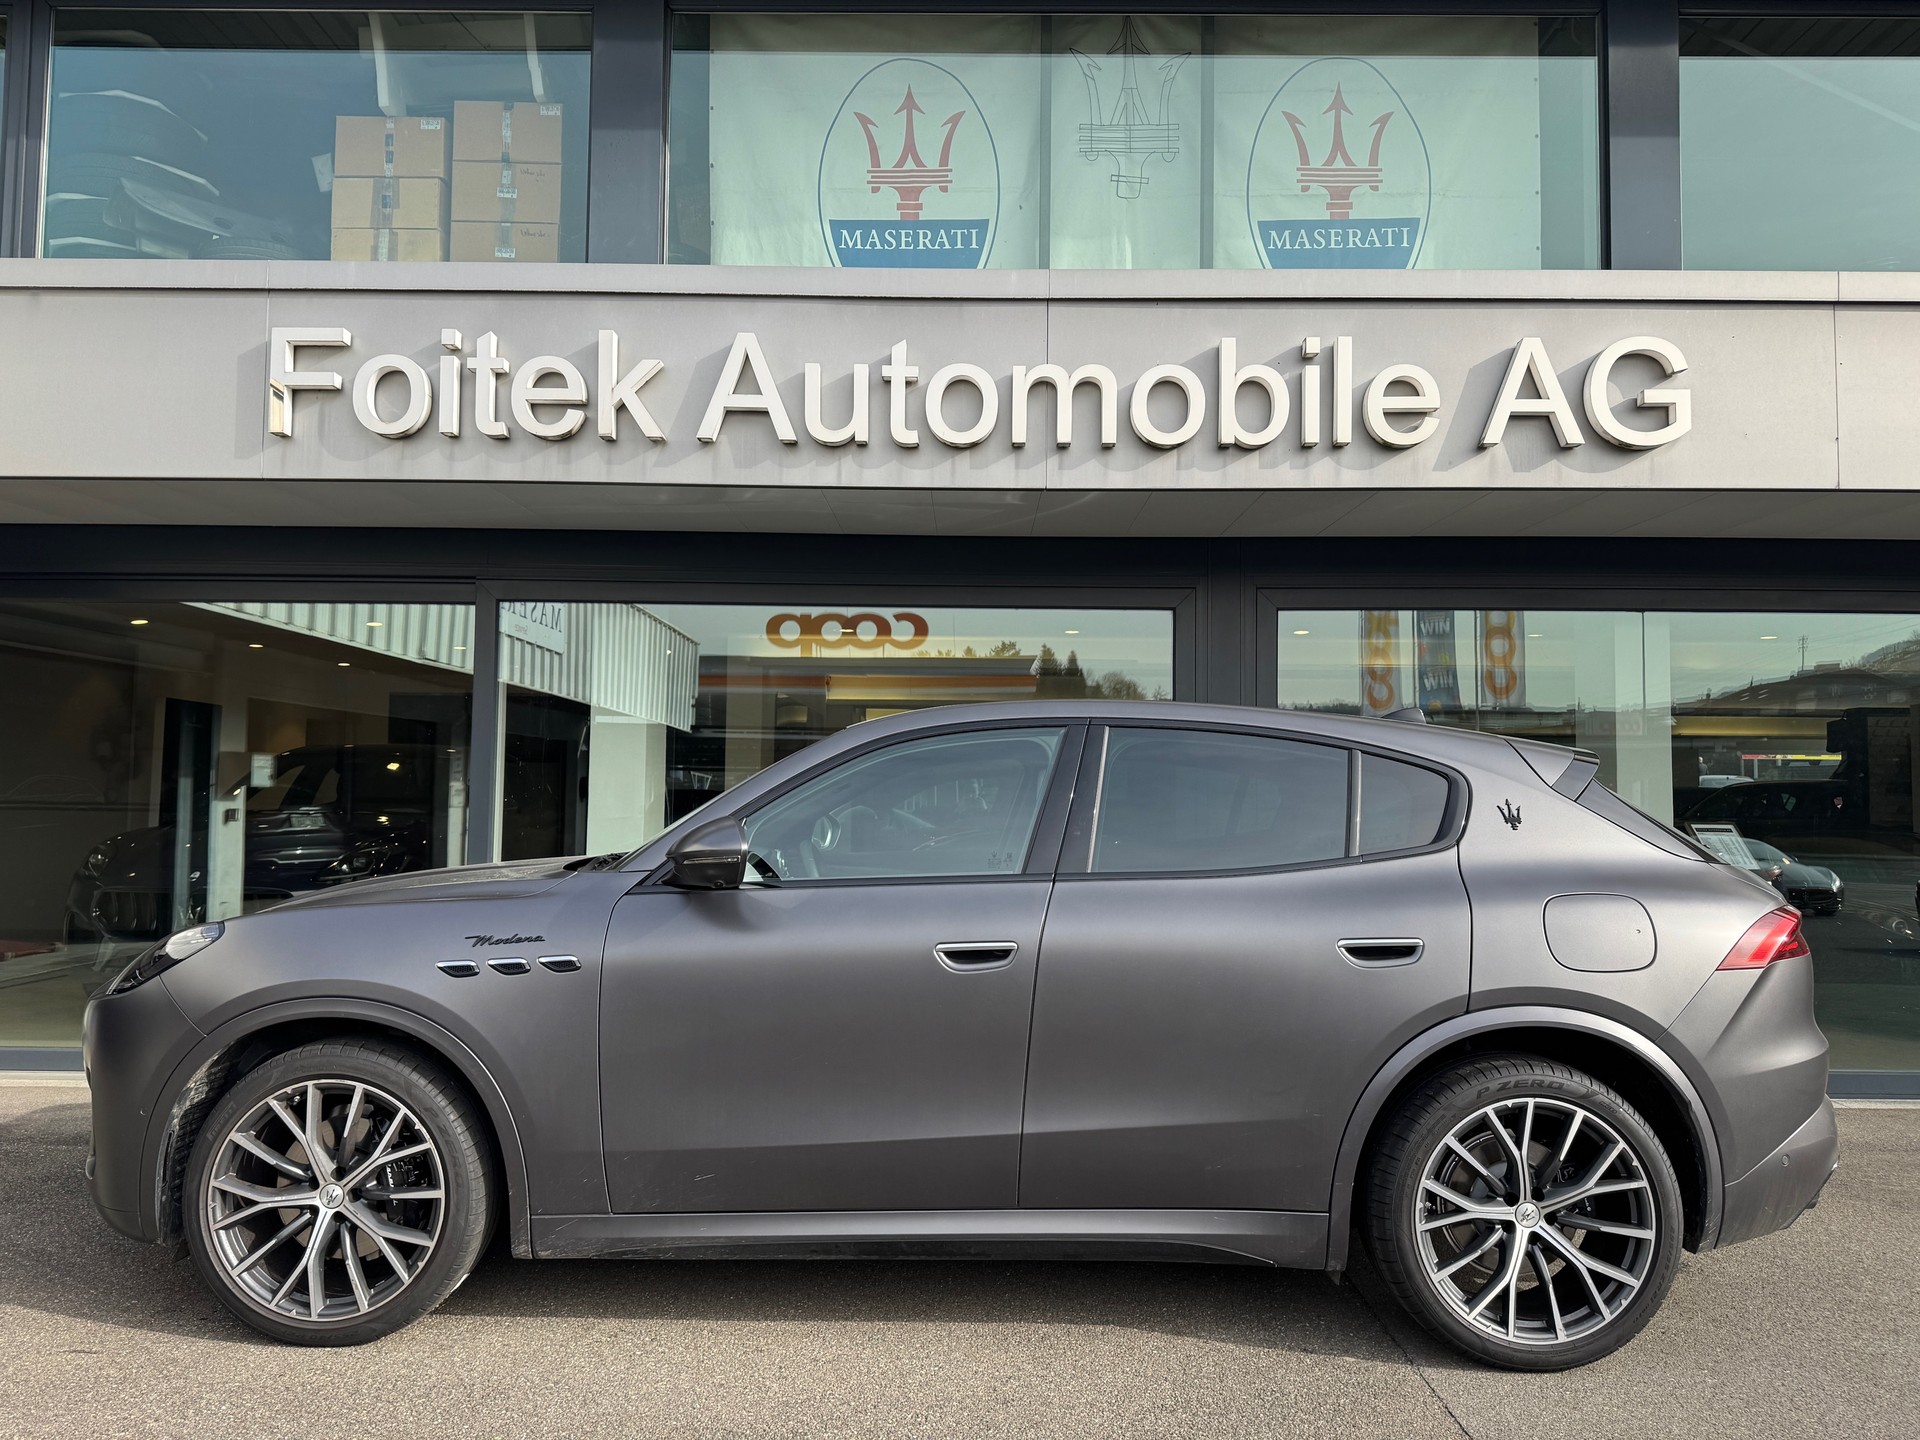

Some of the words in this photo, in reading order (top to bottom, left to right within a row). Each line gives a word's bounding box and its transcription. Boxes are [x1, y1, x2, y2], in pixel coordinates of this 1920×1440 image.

[838, 228, 979, 250] MASERATI
[1267, 227, 1410, 249] MASERATI
[268, 326, 666, 442] Foitek
[696, 331, 1441, 450] Automobile
[1479, 335, 1692, 451] AG
[1420, 617, 1450, 636] WIN
[1423, 672, 1454, 691] WIN
[464, 933, 546, 948] Modena
[1476, 1086, 1490, 1100] P
[1496, 1079, 1566, 1093] ZERO
